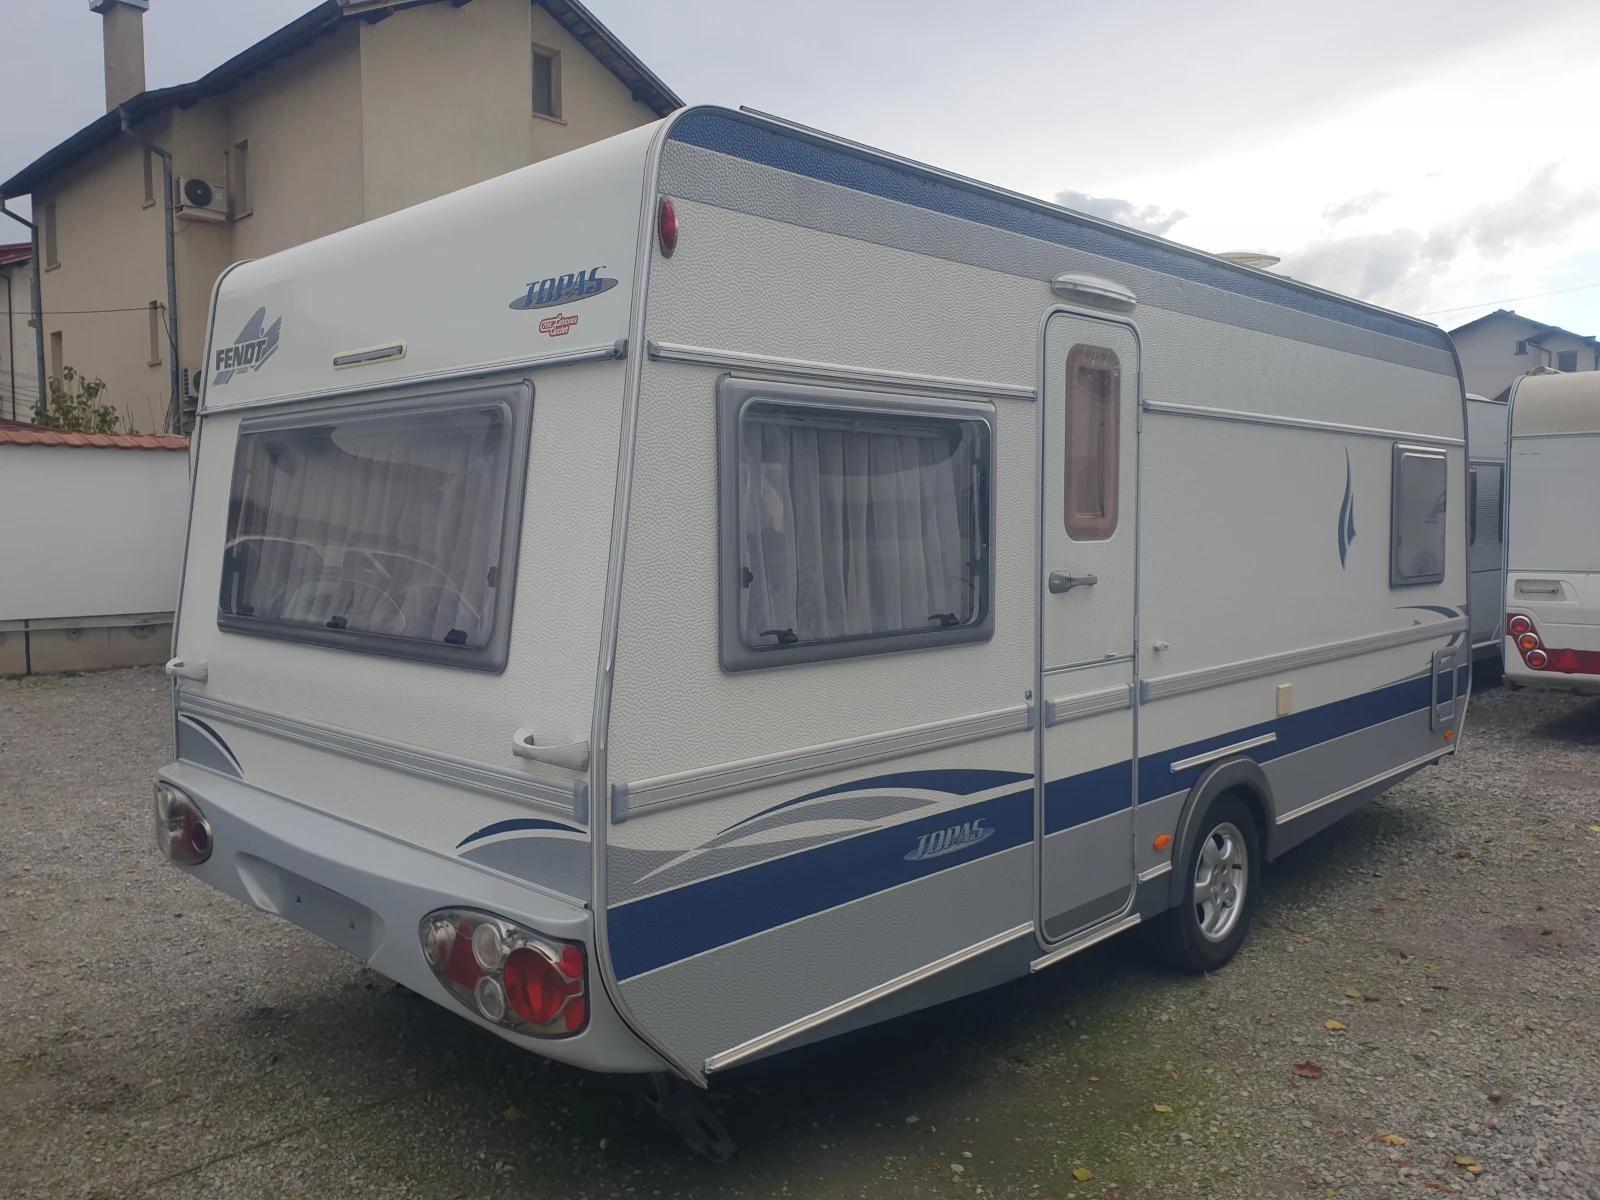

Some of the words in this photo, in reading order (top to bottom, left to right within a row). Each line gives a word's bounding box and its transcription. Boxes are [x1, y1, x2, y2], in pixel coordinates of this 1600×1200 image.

[523, 265, 607, 308] TOPAS
[215, 339, 267, 371] FENDT
[916, 817, 986, 859] TOPAS
